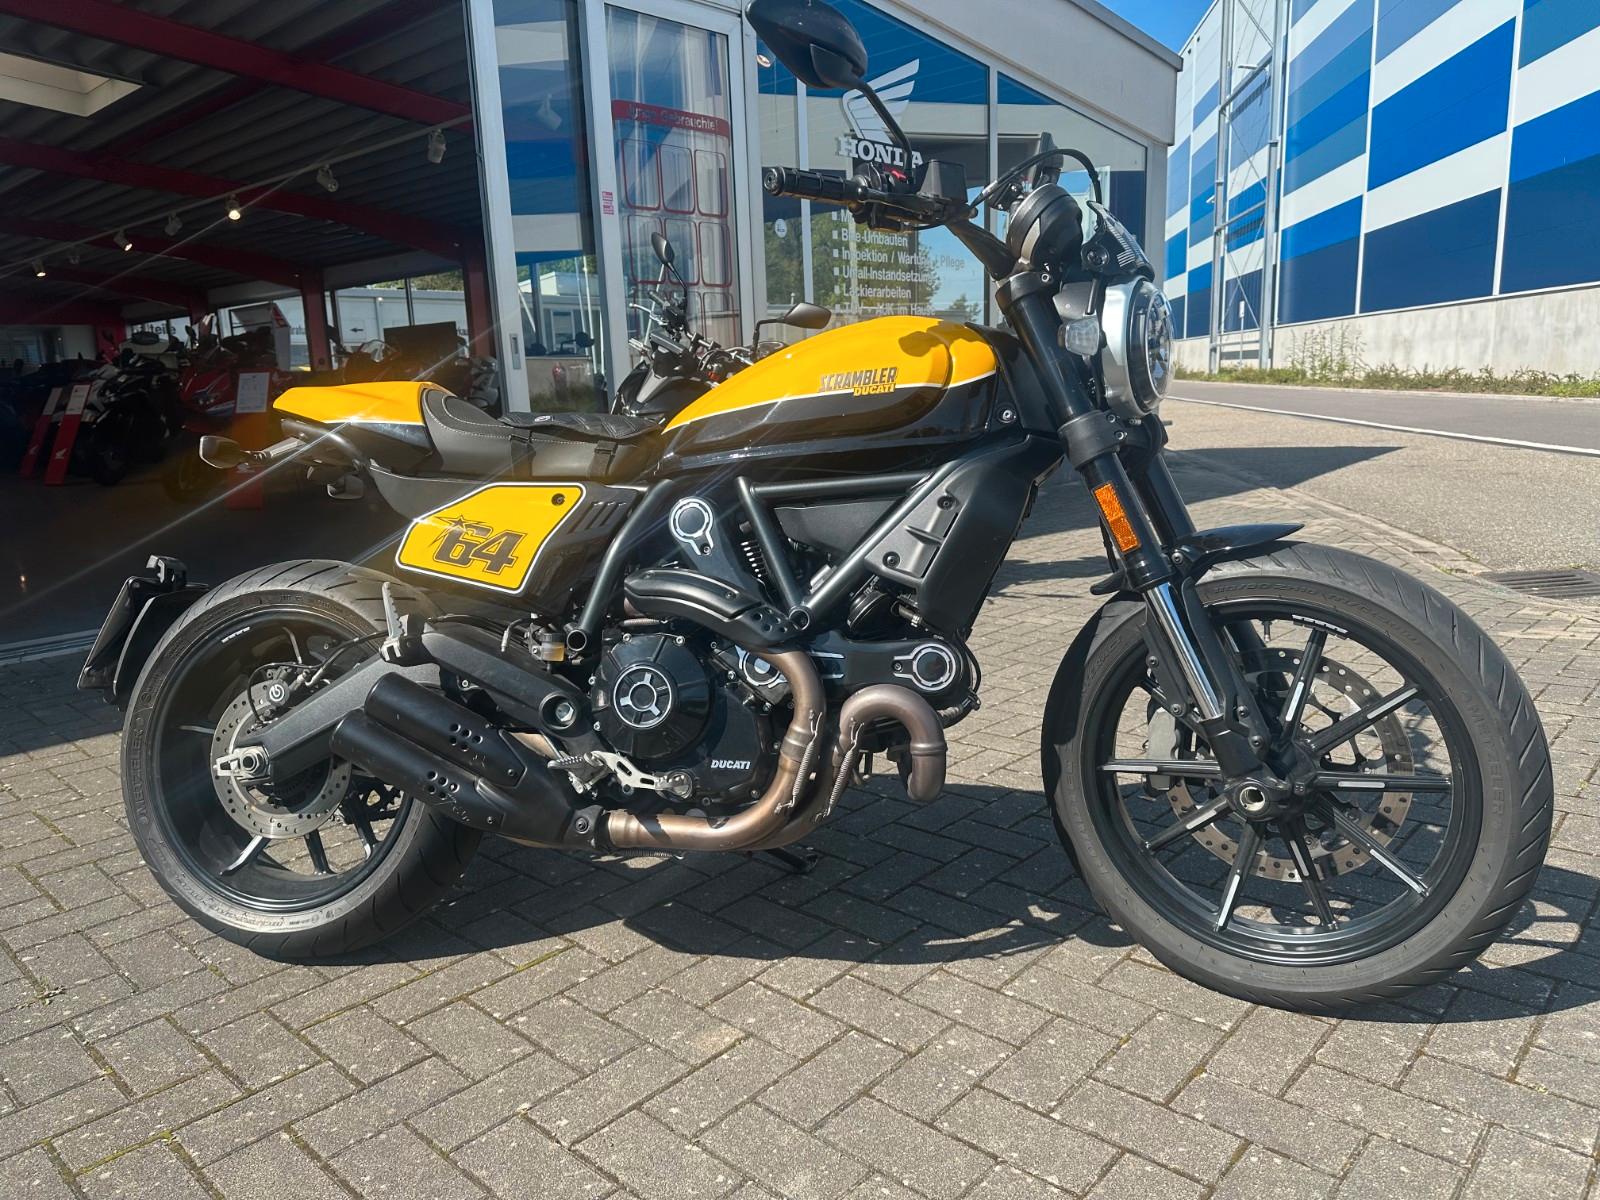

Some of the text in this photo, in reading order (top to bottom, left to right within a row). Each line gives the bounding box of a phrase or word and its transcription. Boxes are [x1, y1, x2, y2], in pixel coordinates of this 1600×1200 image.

[819, 366, 898, 392] SCRAMBLER
[853, 383, 896, 397] DUCATI
[433, 522, 528, 575] 64
[711, 759, 751, 770] DUCATI
